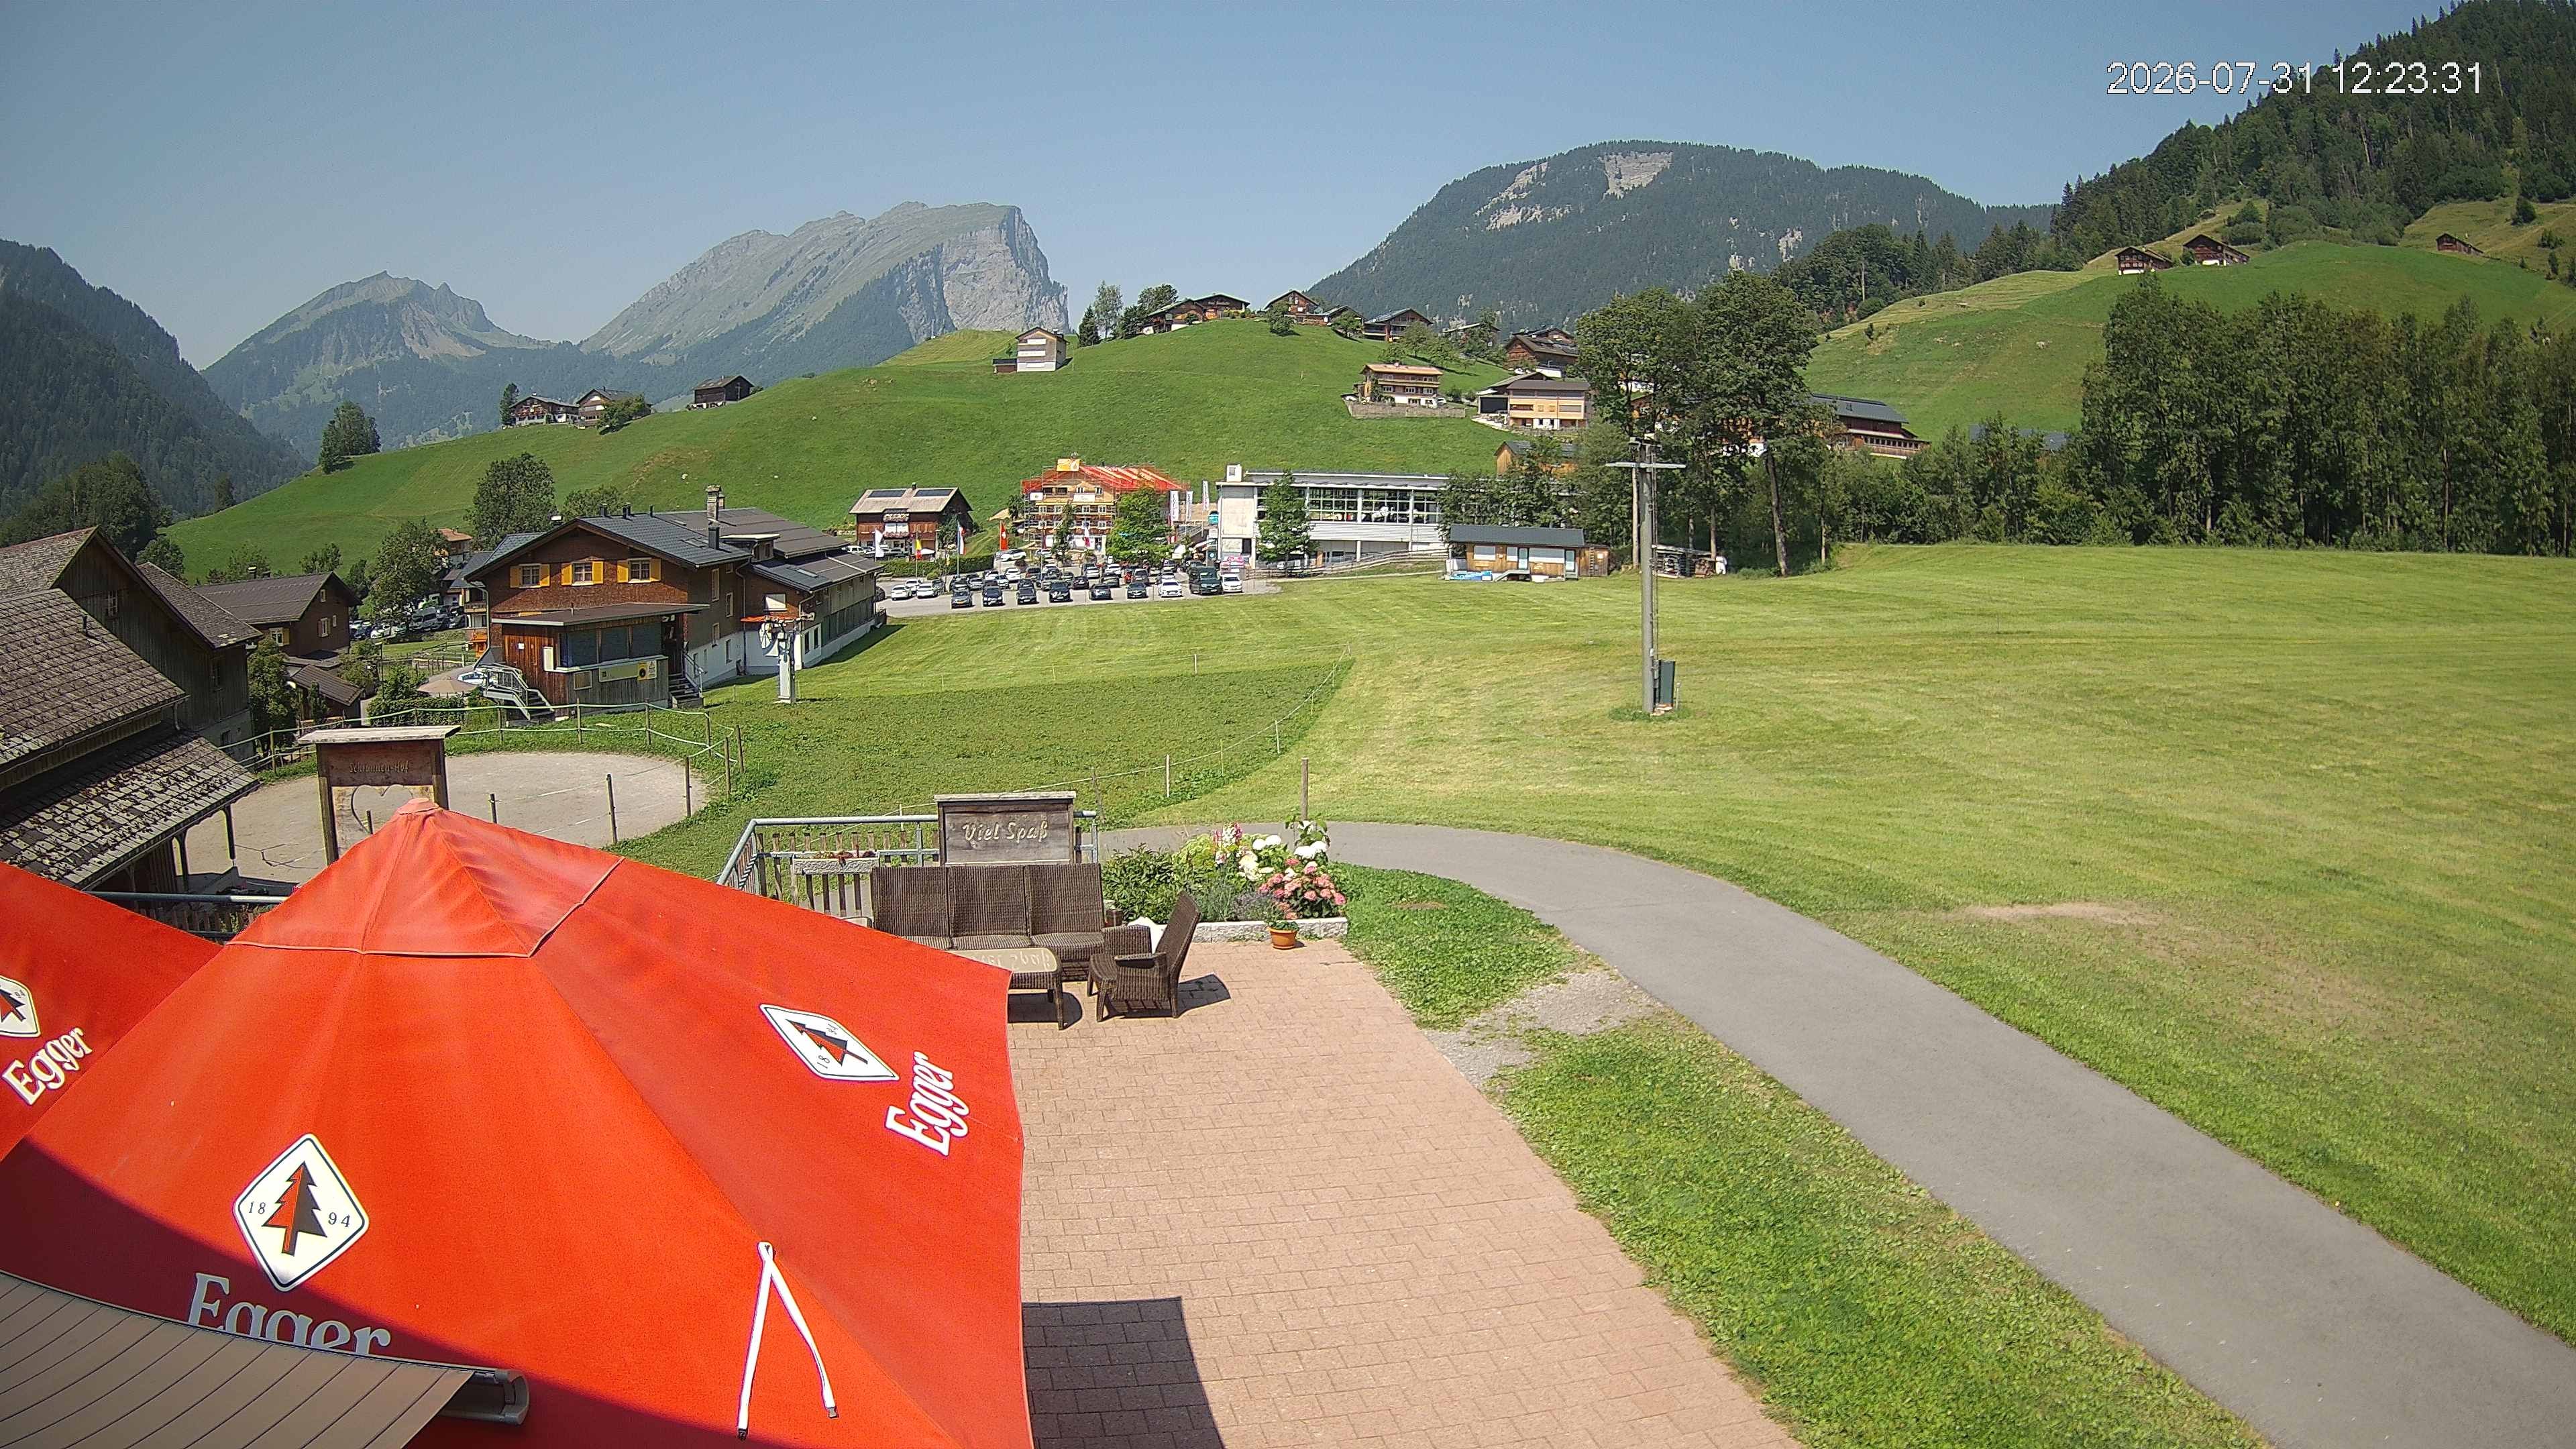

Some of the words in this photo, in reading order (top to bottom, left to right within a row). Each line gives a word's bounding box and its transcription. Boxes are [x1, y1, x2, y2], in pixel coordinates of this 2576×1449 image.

[962, 822, 1000, 841] Viel
[1006, 820, 1048, 843] Spaß
[2, 1027, 93, 1106] Egger
[885, 1051, 970, 1157] Egger
[248, 1201, 266, 1215] 18
[327, 1212, 351, 1228] 94
